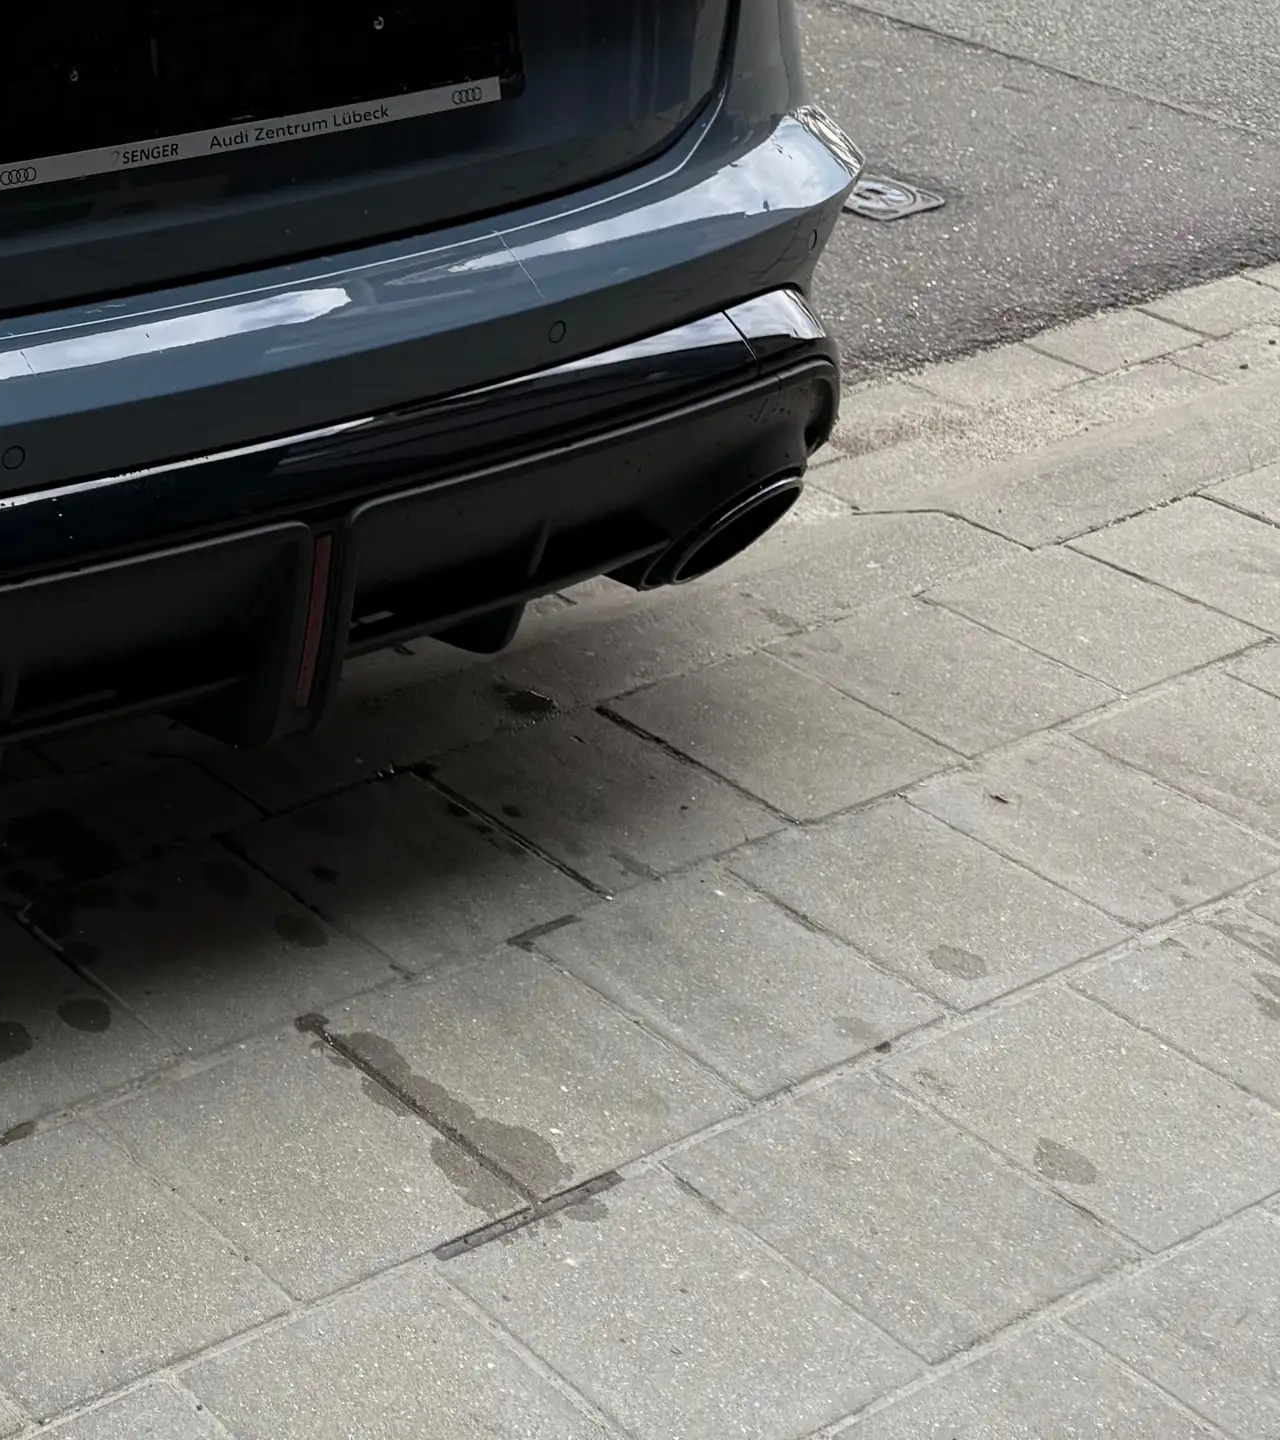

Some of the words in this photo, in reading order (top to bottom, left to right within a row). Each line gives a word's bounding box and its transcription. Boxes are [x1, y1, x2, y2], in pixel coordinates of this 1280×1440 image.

[122, 143, 180, 165] SENGER
[209, 130, 249, 150] Audi
[254, 119, 328, 142] Zentrum
[333, 105, 390, 127] Lübeck
